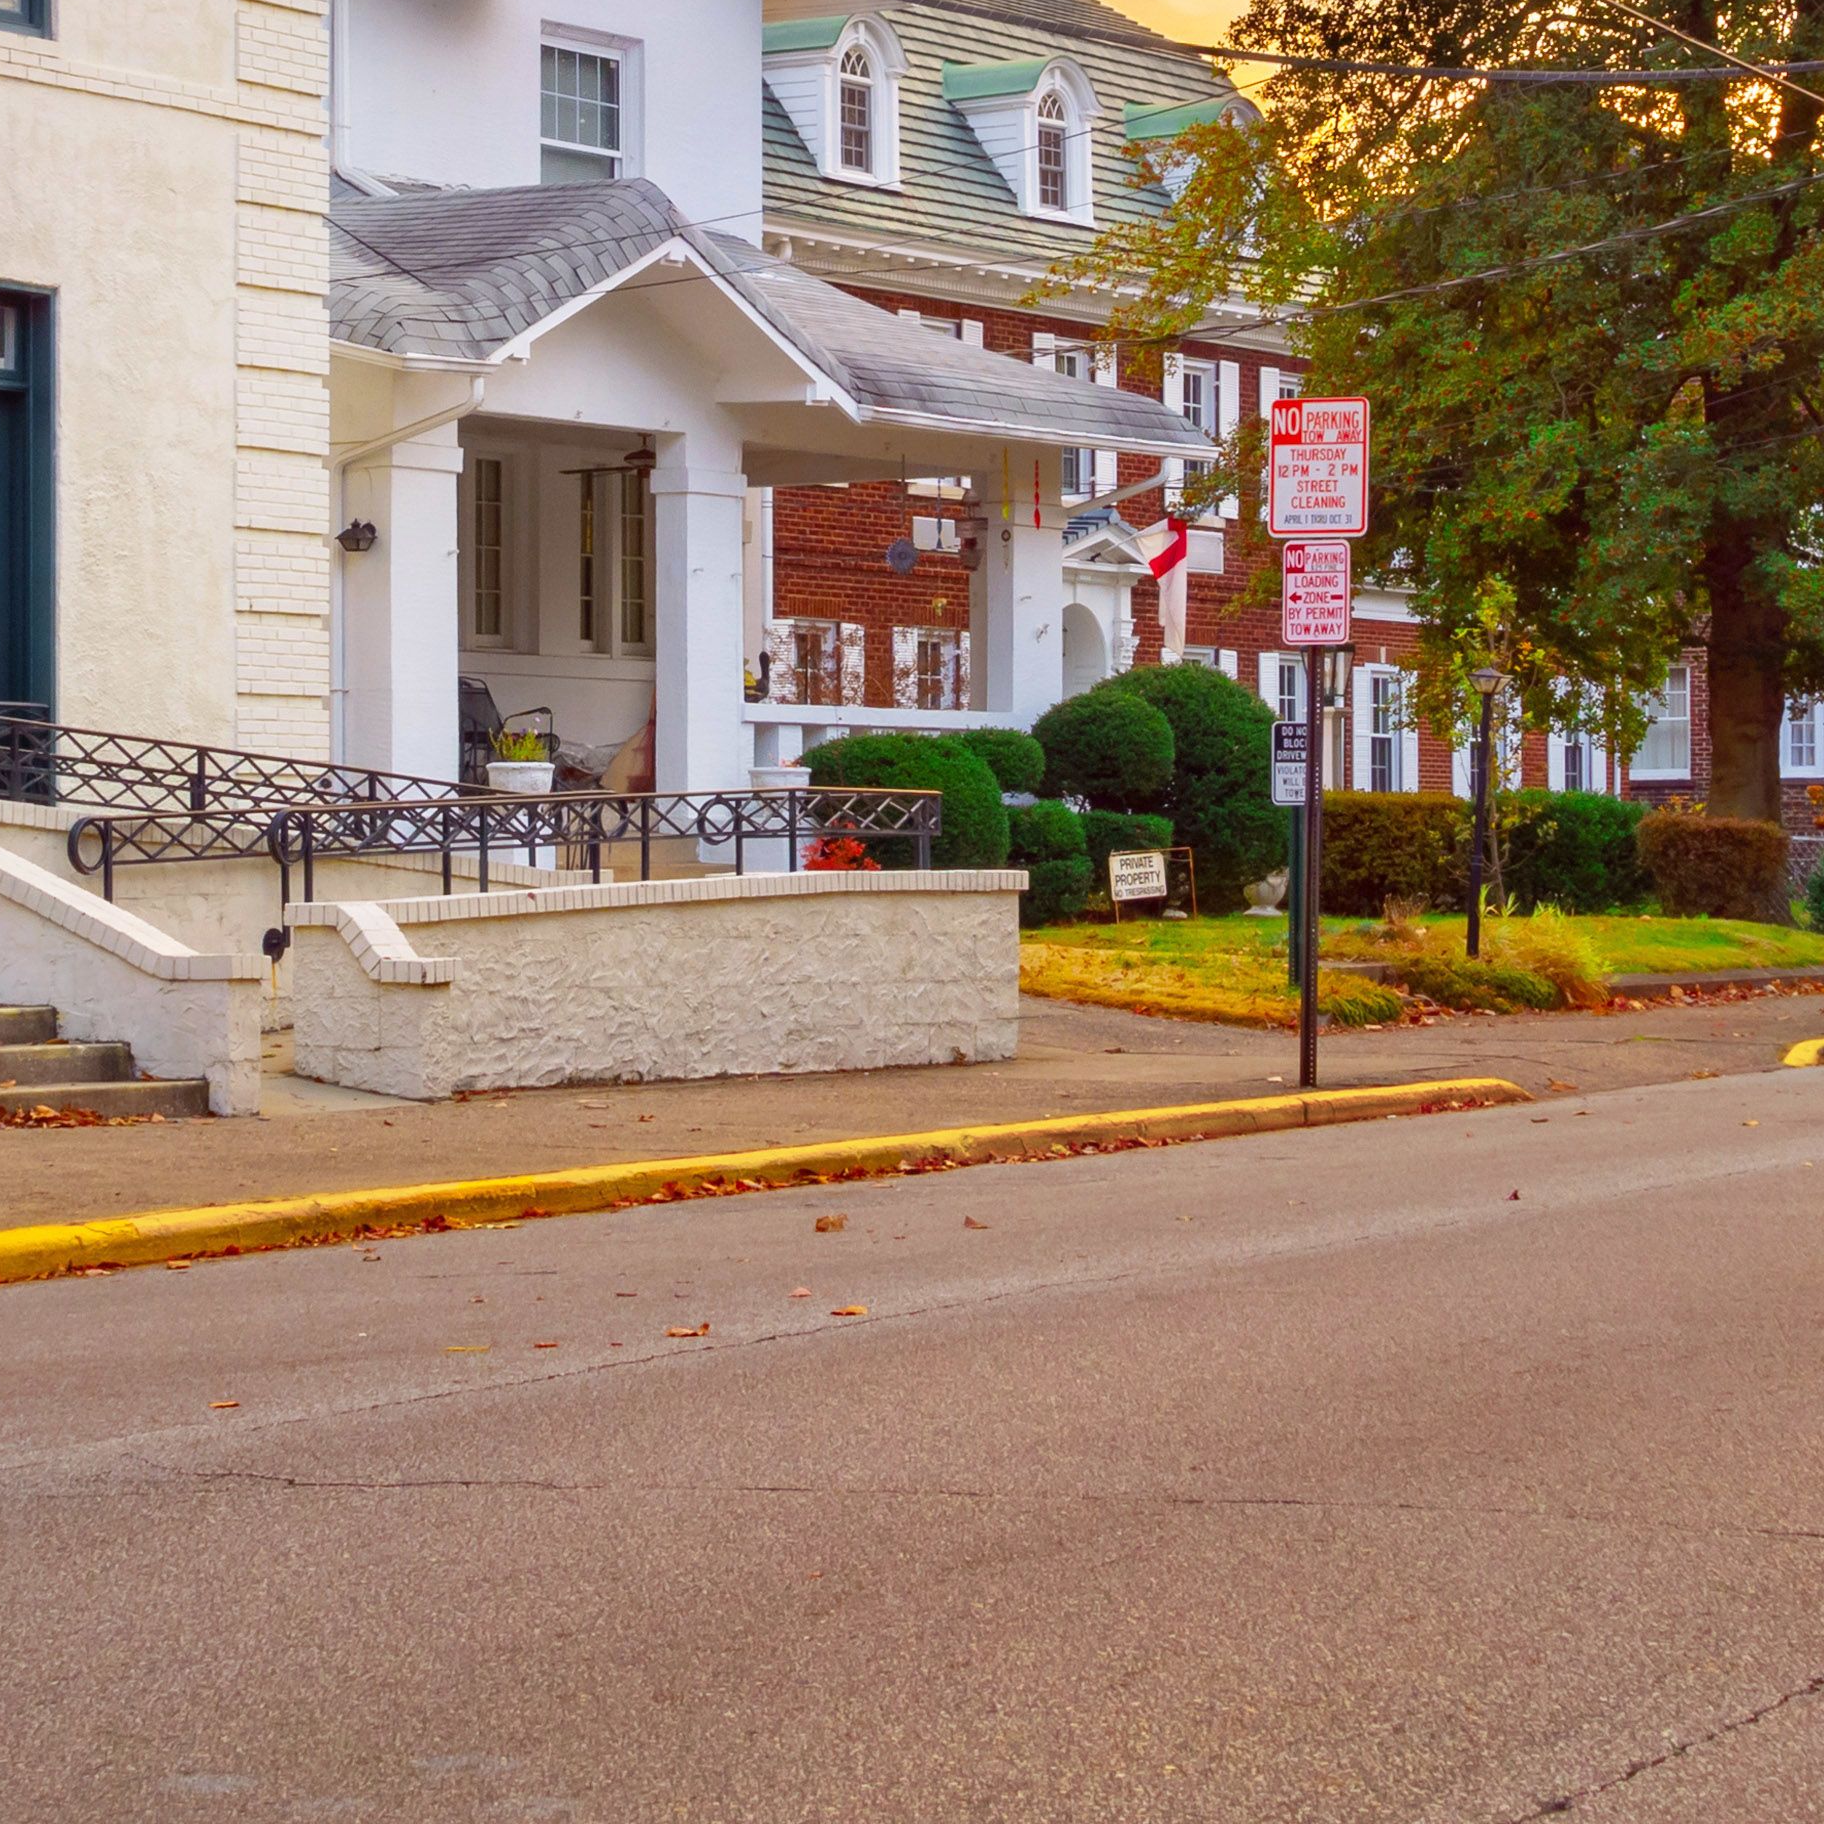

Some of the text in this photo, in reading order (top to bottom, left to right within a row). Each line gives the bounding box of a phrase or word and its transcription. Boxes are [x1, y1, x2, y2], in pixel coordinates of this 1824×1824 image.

[1274, 407, 1360, 435] NO PARKING
[1303, 429, 1362, 442] TOW AWAY
[1290, 448, 1347, 461] THURSDAY
[1278, 465, 1288, 478] 12
[1292, 465, 1309, 477] PM
[1328, 463, 1335, 476] 2
[1341, 464, 1358, 476] PM
[1297, 480, 1338, 493] STREET
[1291, 496, 1346, 509] CLEANING
[1284, 515, 1302, 525] APRIL
[1310, 514, 1328, 524] THRU
[1329, 514, 1342, 524] OCT
[1345, 514, 1352, 524] 31
[1287, 550, 1344, 568] NO PARKING
[1294, 576, 1338, 588] LOADING
[1303, 591, 1330, 604] ZONE
[1289, 607, 1343, 620] BY PERMIT
[1290, 623, 1342, 635] TOW AWAY
[1282, 726, 1307, 736] DO NO
[1283, 738, 1307, 748] BLOC
[1277, 750, 1307, 760] DRIVEW
[1285, 789, 1304, 798] TOWE
[1120, 856, 1154, 870] PRIVATE
[1115, 871, 1160, 886] PROPERTY
